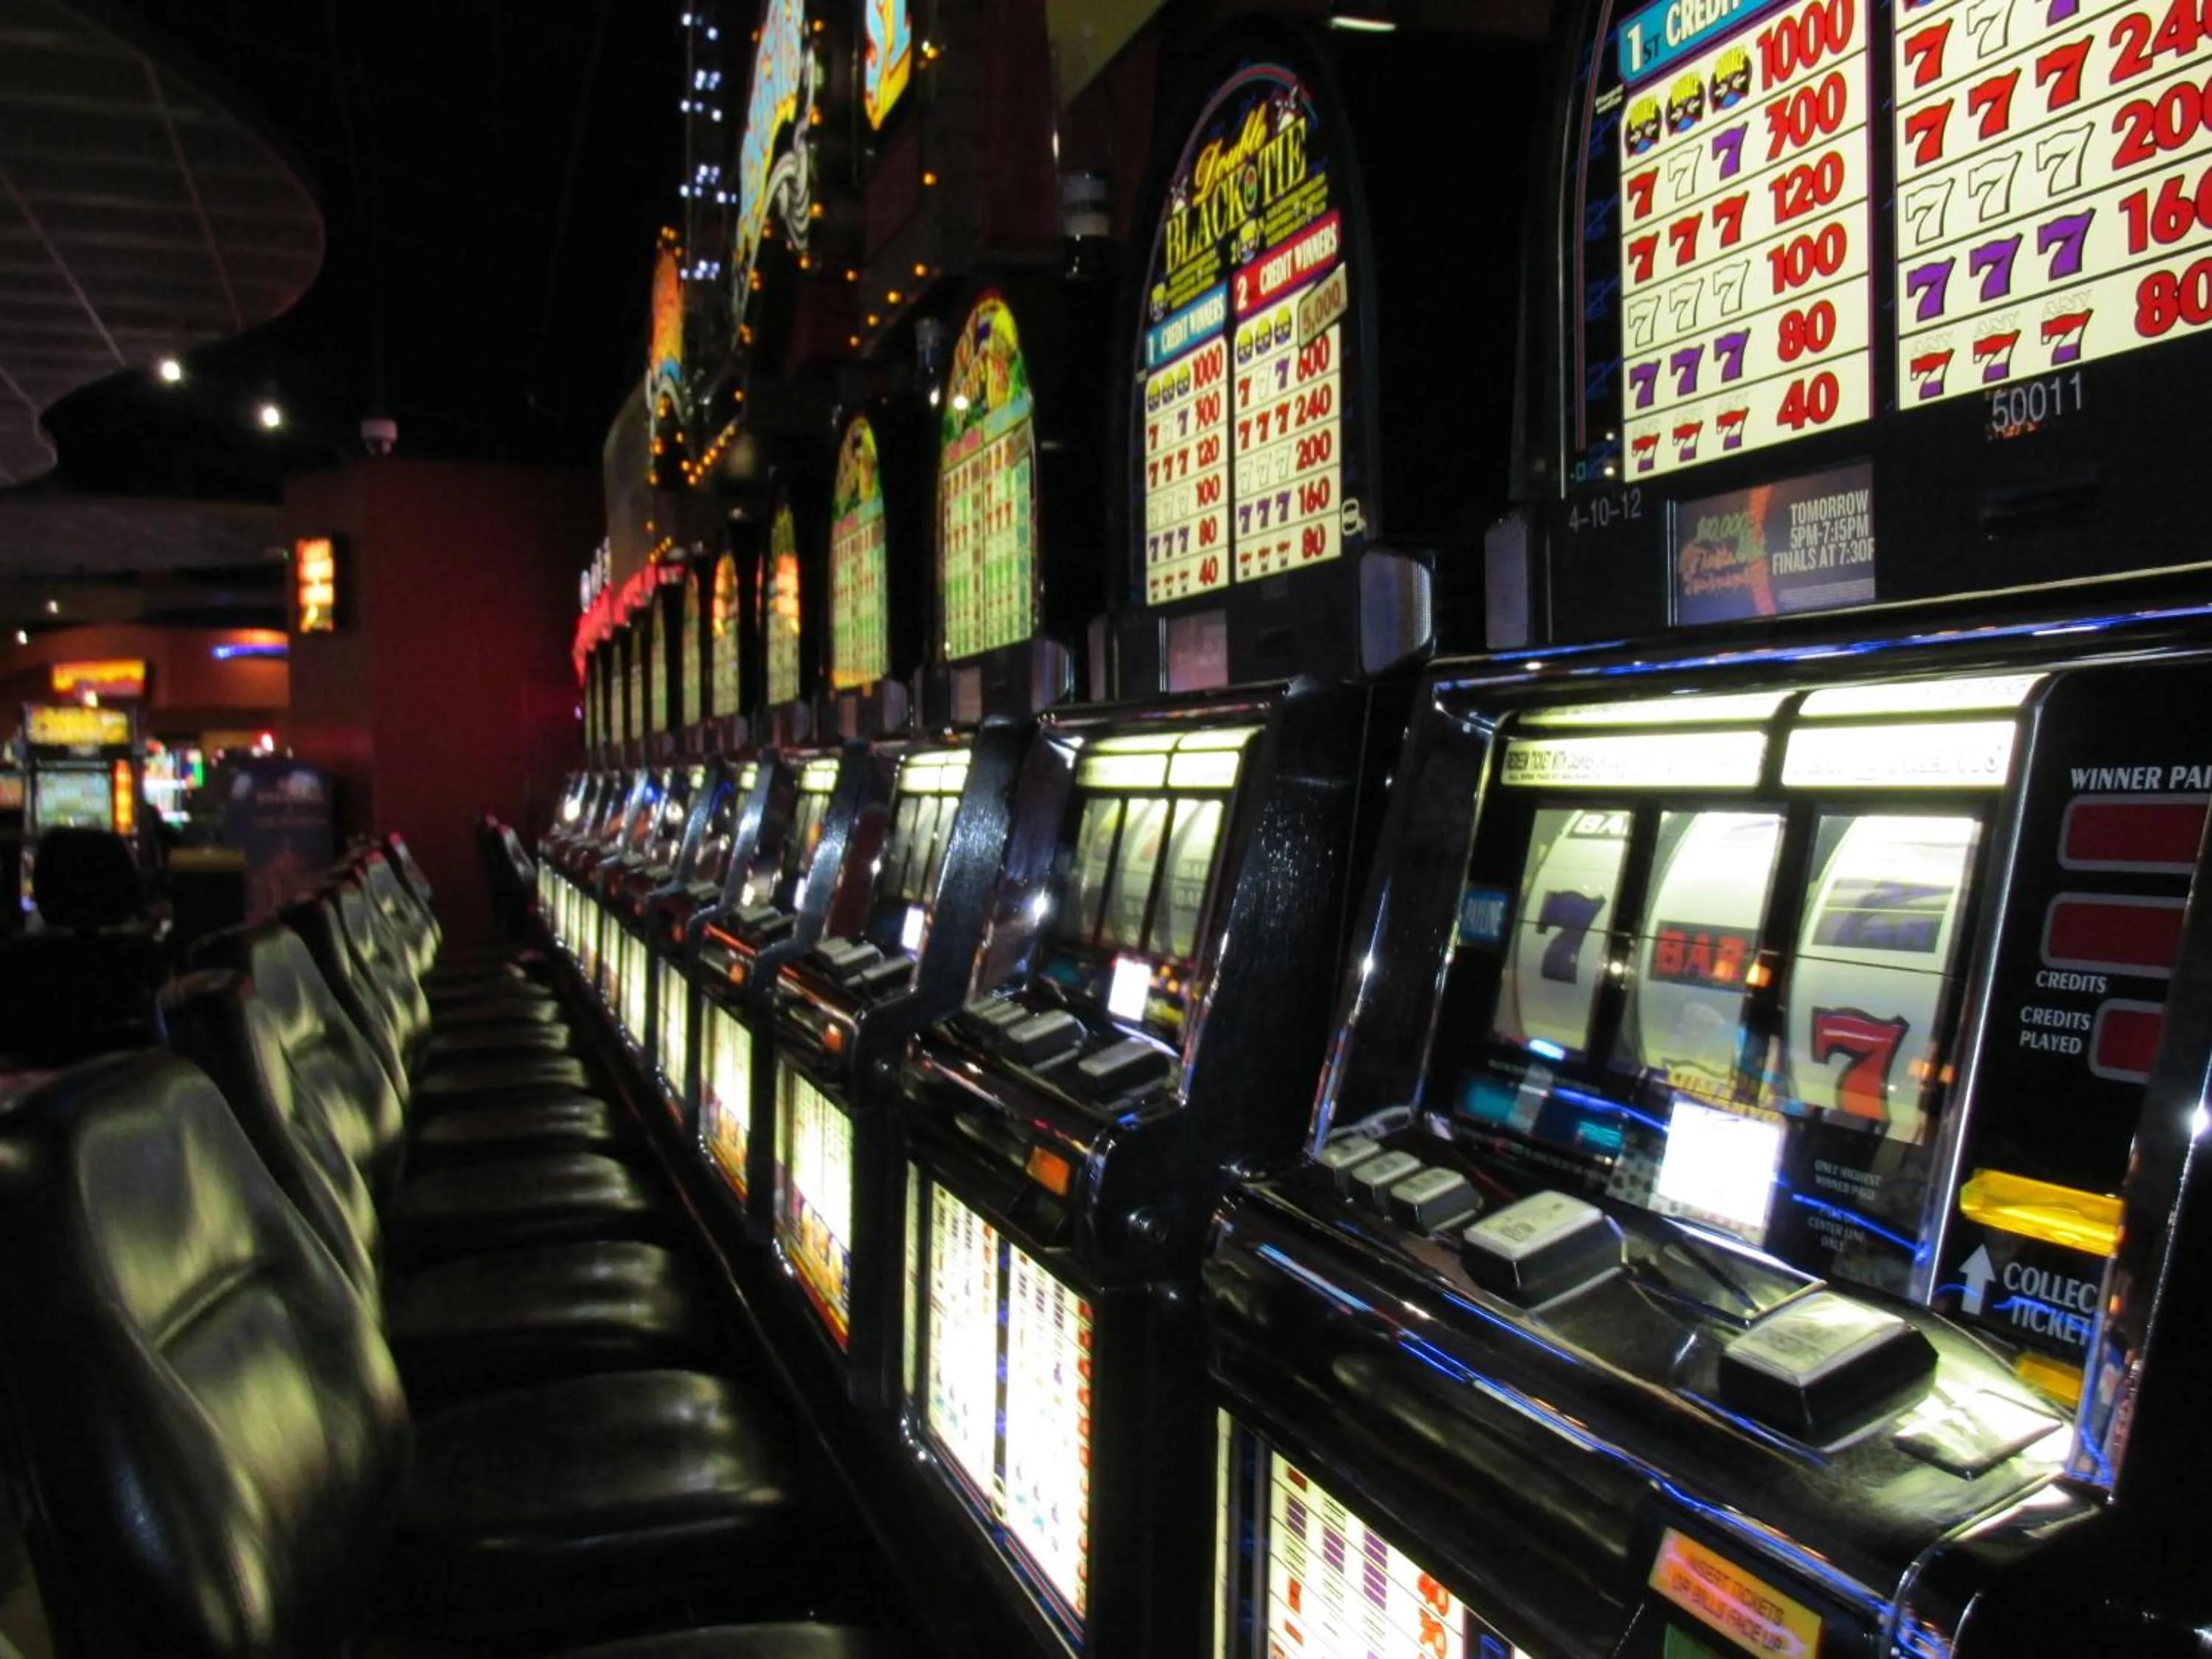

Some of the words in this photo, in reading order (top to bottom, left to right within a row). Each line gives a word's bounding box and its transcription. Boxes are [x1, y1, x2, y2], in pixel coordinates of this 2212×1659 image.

[1756, 0, 1854, 91] 1000
[1905, 18, 1953, 89] 7
[1905, 98, 1955, 168] 7
[1968, 68, 2022, 141] 7
[2036, 35, 2095, 112] 7
[2109, 0, 2212, 85] 24
[1628, 167, 1659, 220] 7
[1668, 145, 1703, 202] 7
[1712, 121, 1749, 181] 7
[1764, 71, 1847, 161] 300
[2112, 75, 2212, 171] 20
[1628, 232, 1660, 283] 7
[1670, 212, 1703, 267] 7
[1713, 191, 1749, 248] 7
[1769, 151, 1844, 225] 120
[1767, 222, 1847, 294] 100
[1907, 257, 1956, 323] 7
[1969, 233, 2024, 302] 7
[2037, 207, 2096, 281] 7
[1237, 275, 1248, 313] 2
[1193, 344, 1222, 389] 1000
[1630, 358, 1661, 409] 7
[1671, 344, 1705, 397] 7
[1714, 328, 1750, 383] 7
[1778, 299, 1836, 362] 80
[1295, 383, 1332, 427] 240
[1777, 371, 1839, 431] 40
[1992, 371, 2083, 431] 50011
[1197, 434, 1220, 468] 120
[1295, 429, 1332, 471] 200
[1196, 473, 1220, 506] 100
[1298, 476, 1330, 515] 160
[1568, 487, 1641, 533] 4-10-12
[1790, 488, 1869, 526] TOMORROW
[1790, 514, 1869, 549] 5PM-7:15PM
[1199, 556, 1219, 585] 40
[1772, 547, 1817, 576] FINALS
[1819, 543, 1836, 567] AT
[2070, 766, 2163, 791] WINNER
[1573, 813, 1627, 835] BA
[1653, 928, 1748, 980] BAR
[2035, 970, 2108, 994] CREDITS
[2020, 1006, 2091, 1031] CREDITS
[2019, 1030, 2082, 1054] PLAYED
[1810, 1006, 1910, 1124] 7
[2011, 1297, 2093, 1346] TICKET
